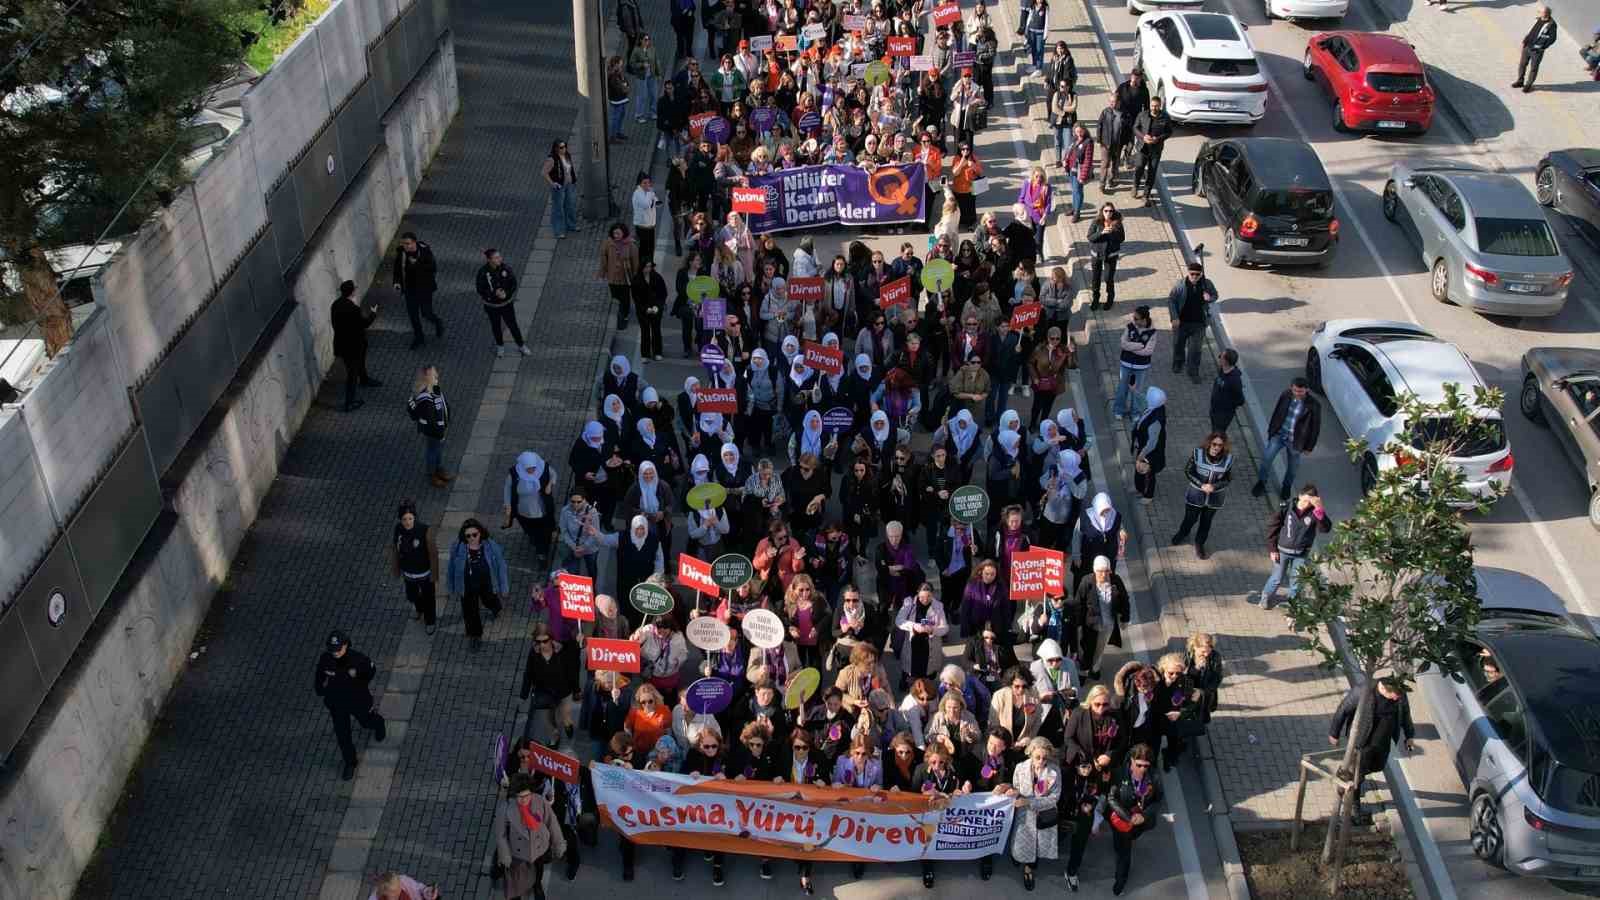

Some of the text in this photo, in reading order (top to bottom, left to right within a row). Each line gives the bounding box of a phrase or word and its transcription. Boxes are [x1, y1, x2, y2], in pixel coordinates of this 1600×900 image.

[889, 41, 912, 52] Yürü
[784, 169, 845, 191] Nilüfer
[784, 189, 834, 208] Kadın
[785, 202, 876, 225] Dernekleri
[789, 283, 822, 295] Diren
[882, 282, 908, 302] Yürü
[1013, 307, 1037, 324] Yürü
[807, 349, 839, 367] Diren
[697, 391, 736, 404] Susma
[1012, 560, 1045, 570] Susma
[1014, 567, 1042, 581] Yürü
[560, 580, 592, 593] Susma
[1012, 581, 1044, 593] Diren
[564, 590, 590, 603] Yürü
[563, 600, 592, 613] Diren
[591, 647, 637, 664] Diren
[533, 751, 573, 777] Yürü
[617, 799, 927, 845] Susma, Yürü, Diren
